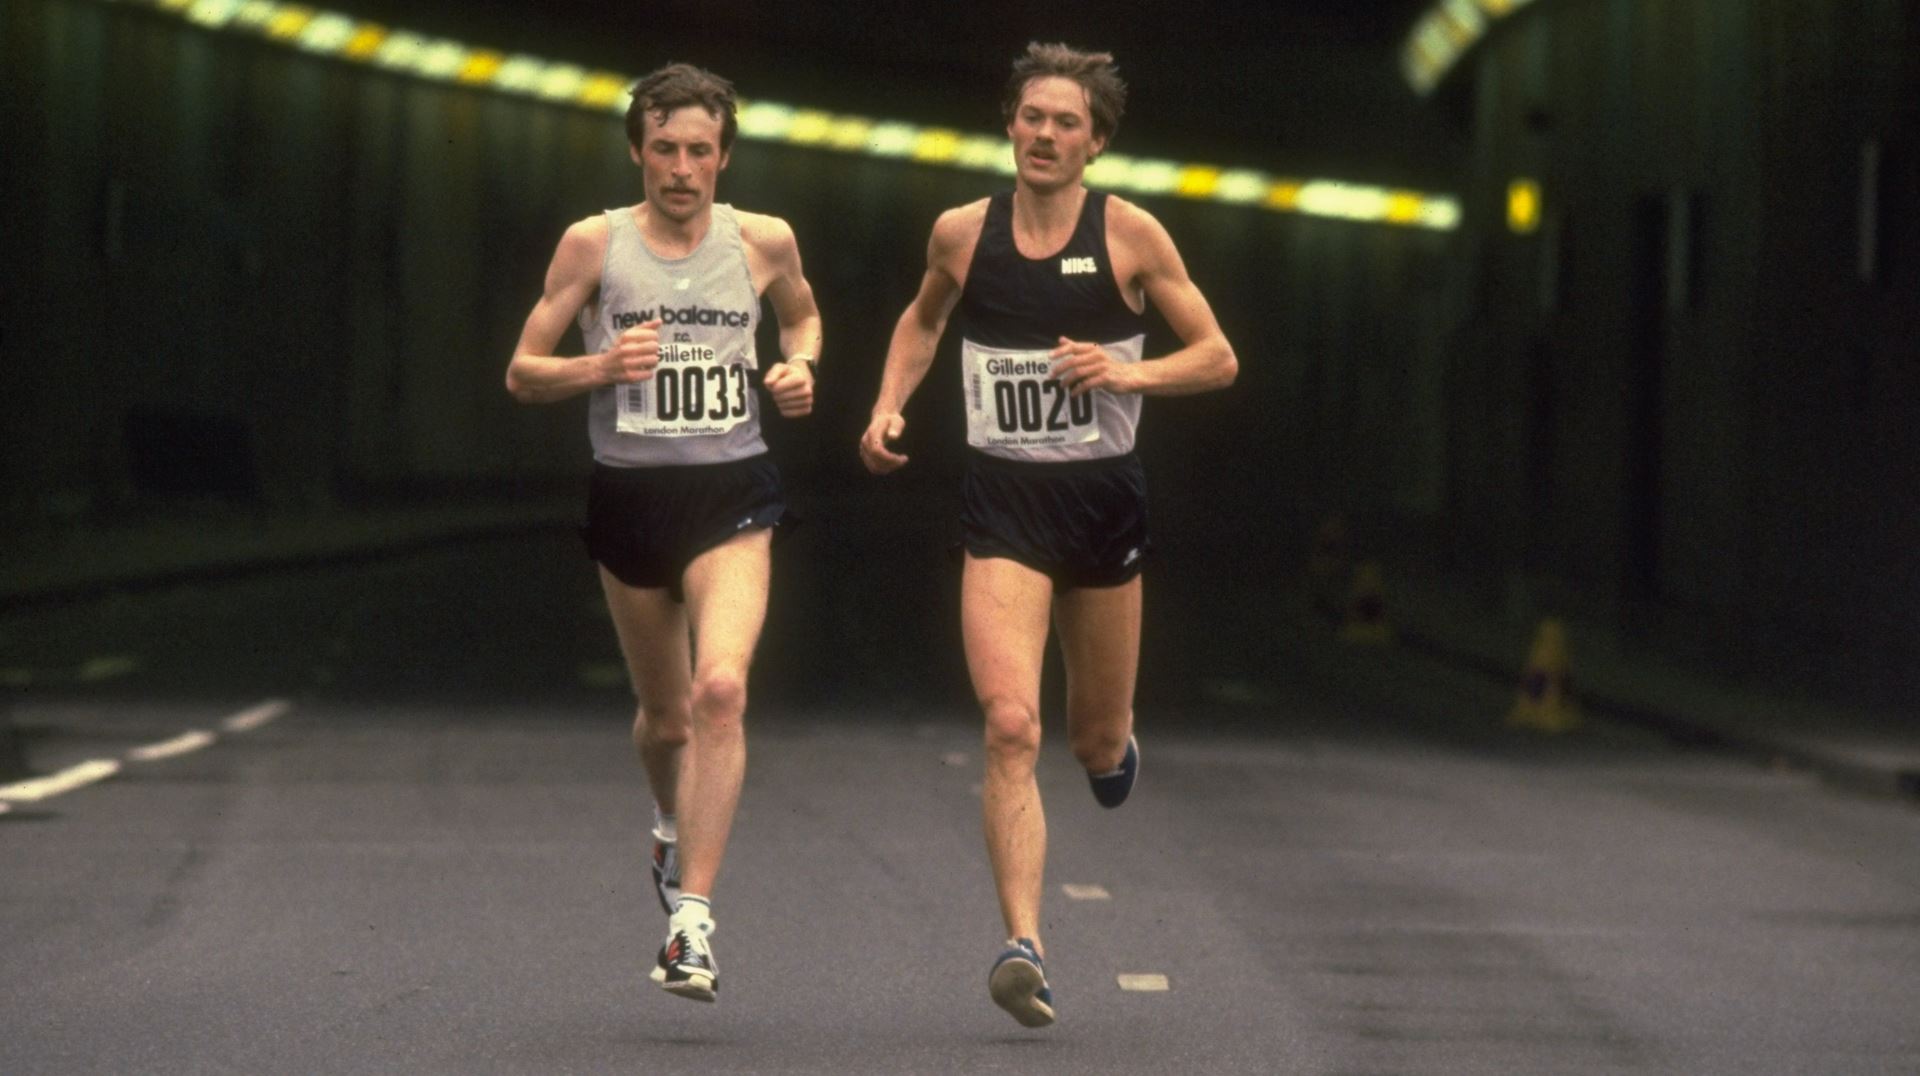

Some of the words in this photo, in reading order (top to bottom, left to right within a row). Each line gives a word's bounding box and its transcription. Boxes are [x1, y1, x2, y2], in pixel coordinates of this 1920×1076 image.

[1061, 257, 1097, 275] NIKE
[612, 309, 654, 329] new
[660, 305, 750, 328] balance
[986, 358, 1049, 377] Gillette
[656, 363, 747, 422] 0033
[994, 379, 1093, 433] 0020
[644, 425, 678, 435] London
[680, 425, 725, 435] Marathon
[987, 436, 1018, 445] London
[1020, 435, 1066, 445] Marathon
